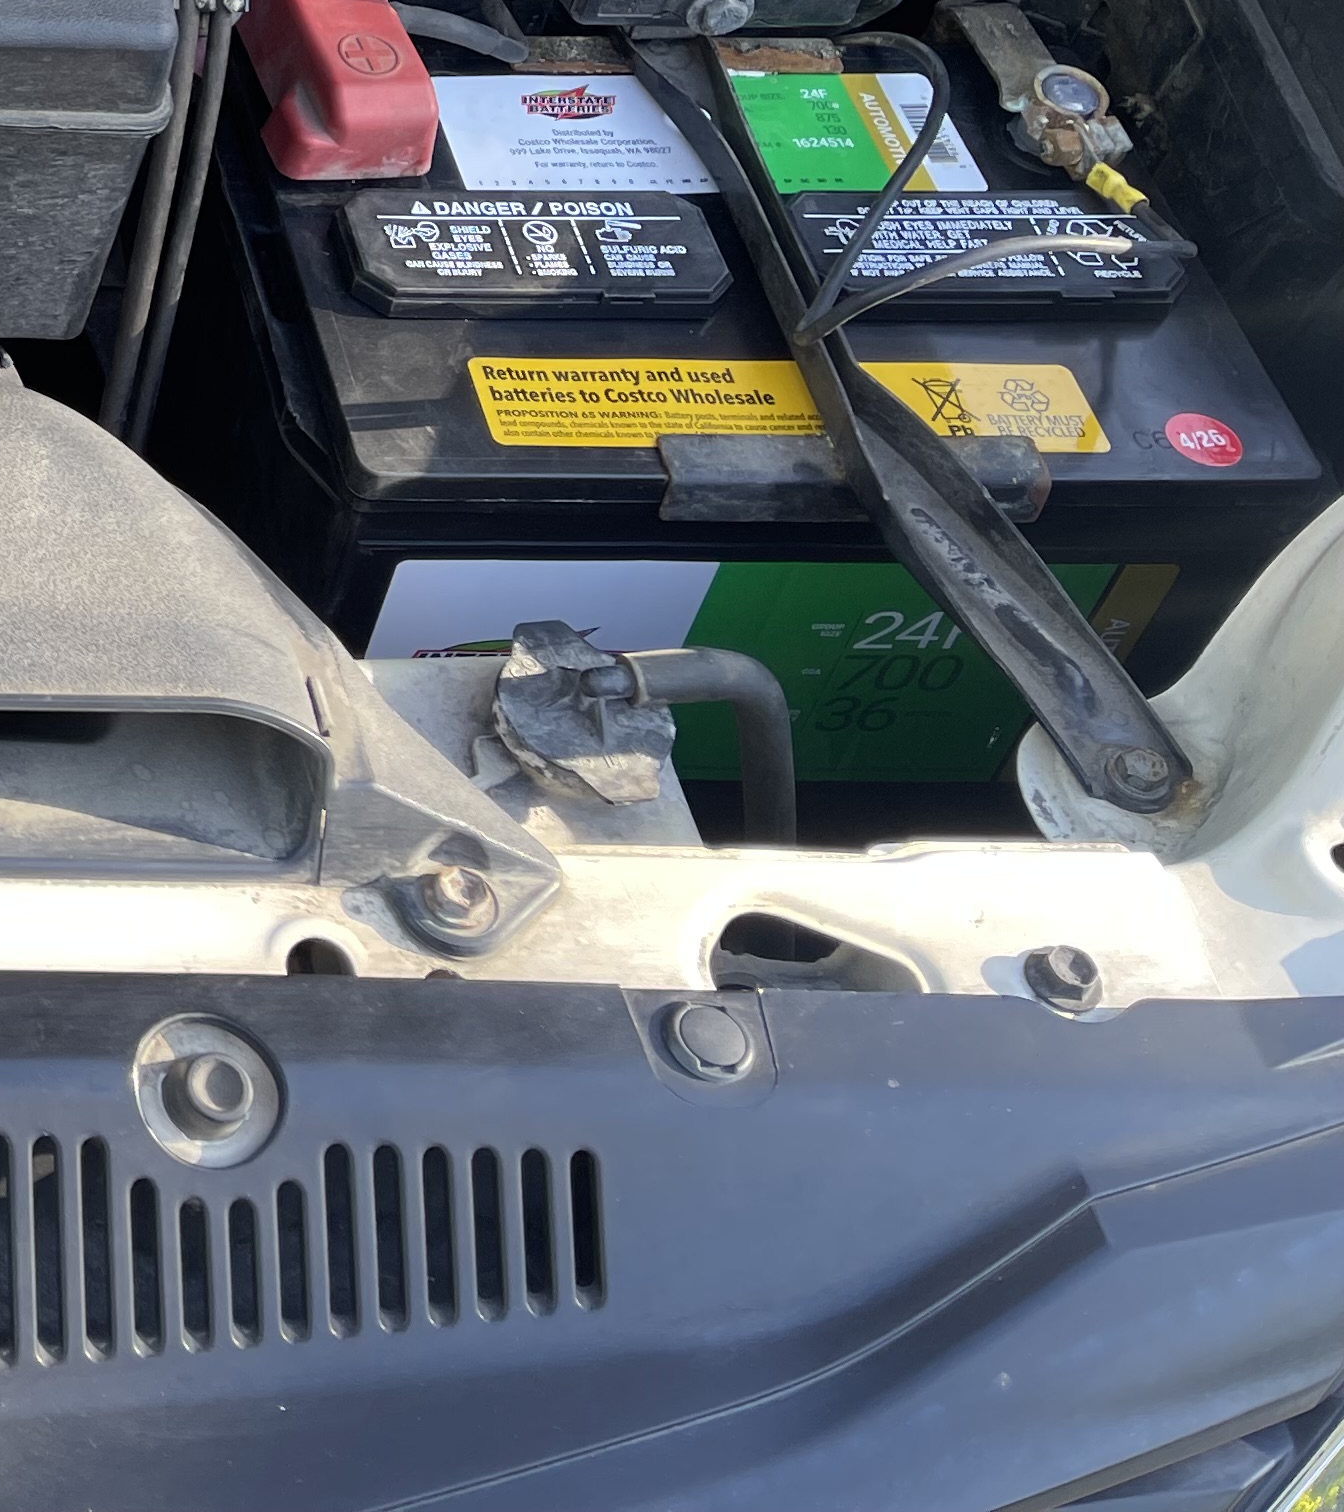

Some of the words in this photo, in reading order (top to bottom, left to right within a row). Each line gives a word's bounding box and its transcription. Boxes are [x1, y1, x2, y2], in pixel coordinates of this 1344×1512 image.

[800, 88, 828, 99] 24F
[521, 95, 616, 105] INTERSTATE
[528, 104, 613, 114] BATTERIES
[815, 113, 841, 123] 875
[551, 129, 601, 137] Distributed
[603, 129, 614, 138] by
[822, 125, 848, 135] 130
[552, 138, 599, 146] Wholesale
[792, 137, 855, 148] 1624514
[528, 147, 548, 155] Lake
[433, 201, 527, 216] DANGER
[548, 202, 635, 216] POISON
[449, 225, 492, 235] SHIELD
[903, 220, 934, 230] EYES
[937, 220, 1013, 231] IMMEDIATELY
[452, 235, 484, 243] EYES
[947, 230, 971, 239] GET
[428, 243, 493, 252] EXPLOSIVE
[536, 244, 555, 253] NO
[872, 239, 925, 249] MEDICAL
[925, 239, 957, 249] HELP
[600, 245, 658, 254] SULFURIC
[659, 245, 688, 254] ACID
[431, 252, 473, 260] GASES
[482, 365, 550, 382] Return
[552, 368, 640, 386] warranty
[645, 367, 684, 382] and
[687, 368, 735, 384] used
[488, 386, 577, 403] batteries
[579, 389, 600, 403] to
[604, 388, 668, 404] Costco
[669, 388, 776, 405] Wholesale
[496, 409, 578, 419] PROPOSITION
[581, 411, 597, 419] 65
[598, 411, 663, 419] WARNING:
[987, 414, 1042, 427] BATTERY
[1046, 414, 1085, 427] MUST
[998, 426, 1017, 437] BE
[1018, 426, 1087, 438] RECYCLED
[1178, 429, 1227, 450] 4/26
[836, 654, 964, 691] 700
[815, 696, 900, 732] 36
